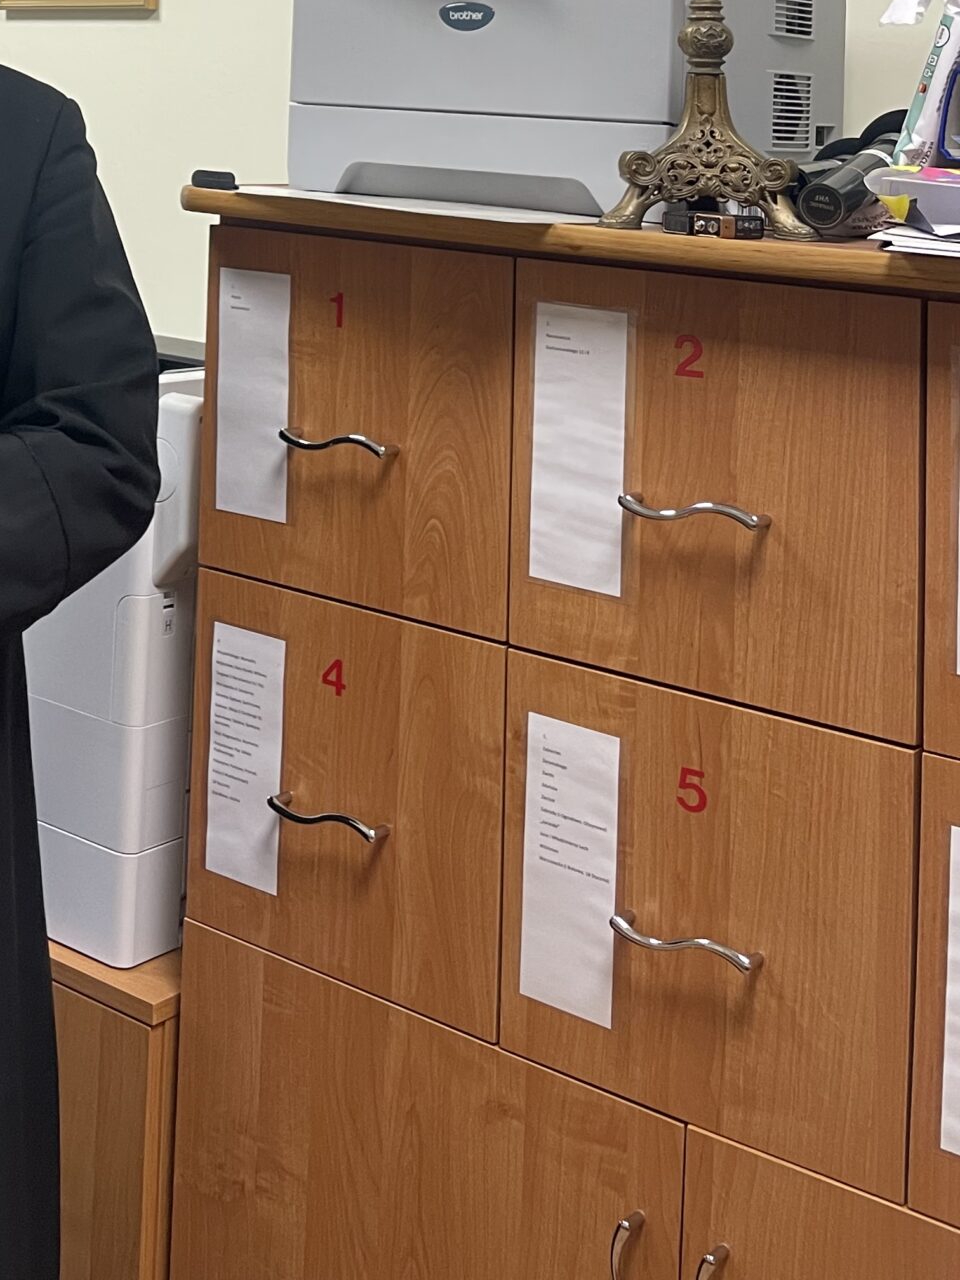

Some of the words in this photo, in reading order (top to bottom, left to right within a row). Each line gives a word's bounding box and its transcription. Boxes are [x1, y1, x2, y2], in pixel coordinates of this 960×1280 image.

[449, 10, 483, 20] brother
[329, 292, 344, 328] 1
[674, 335, 705, 379] 2
[322, 659, 346, 697] 4
[676, 766, 707, 813] 5
